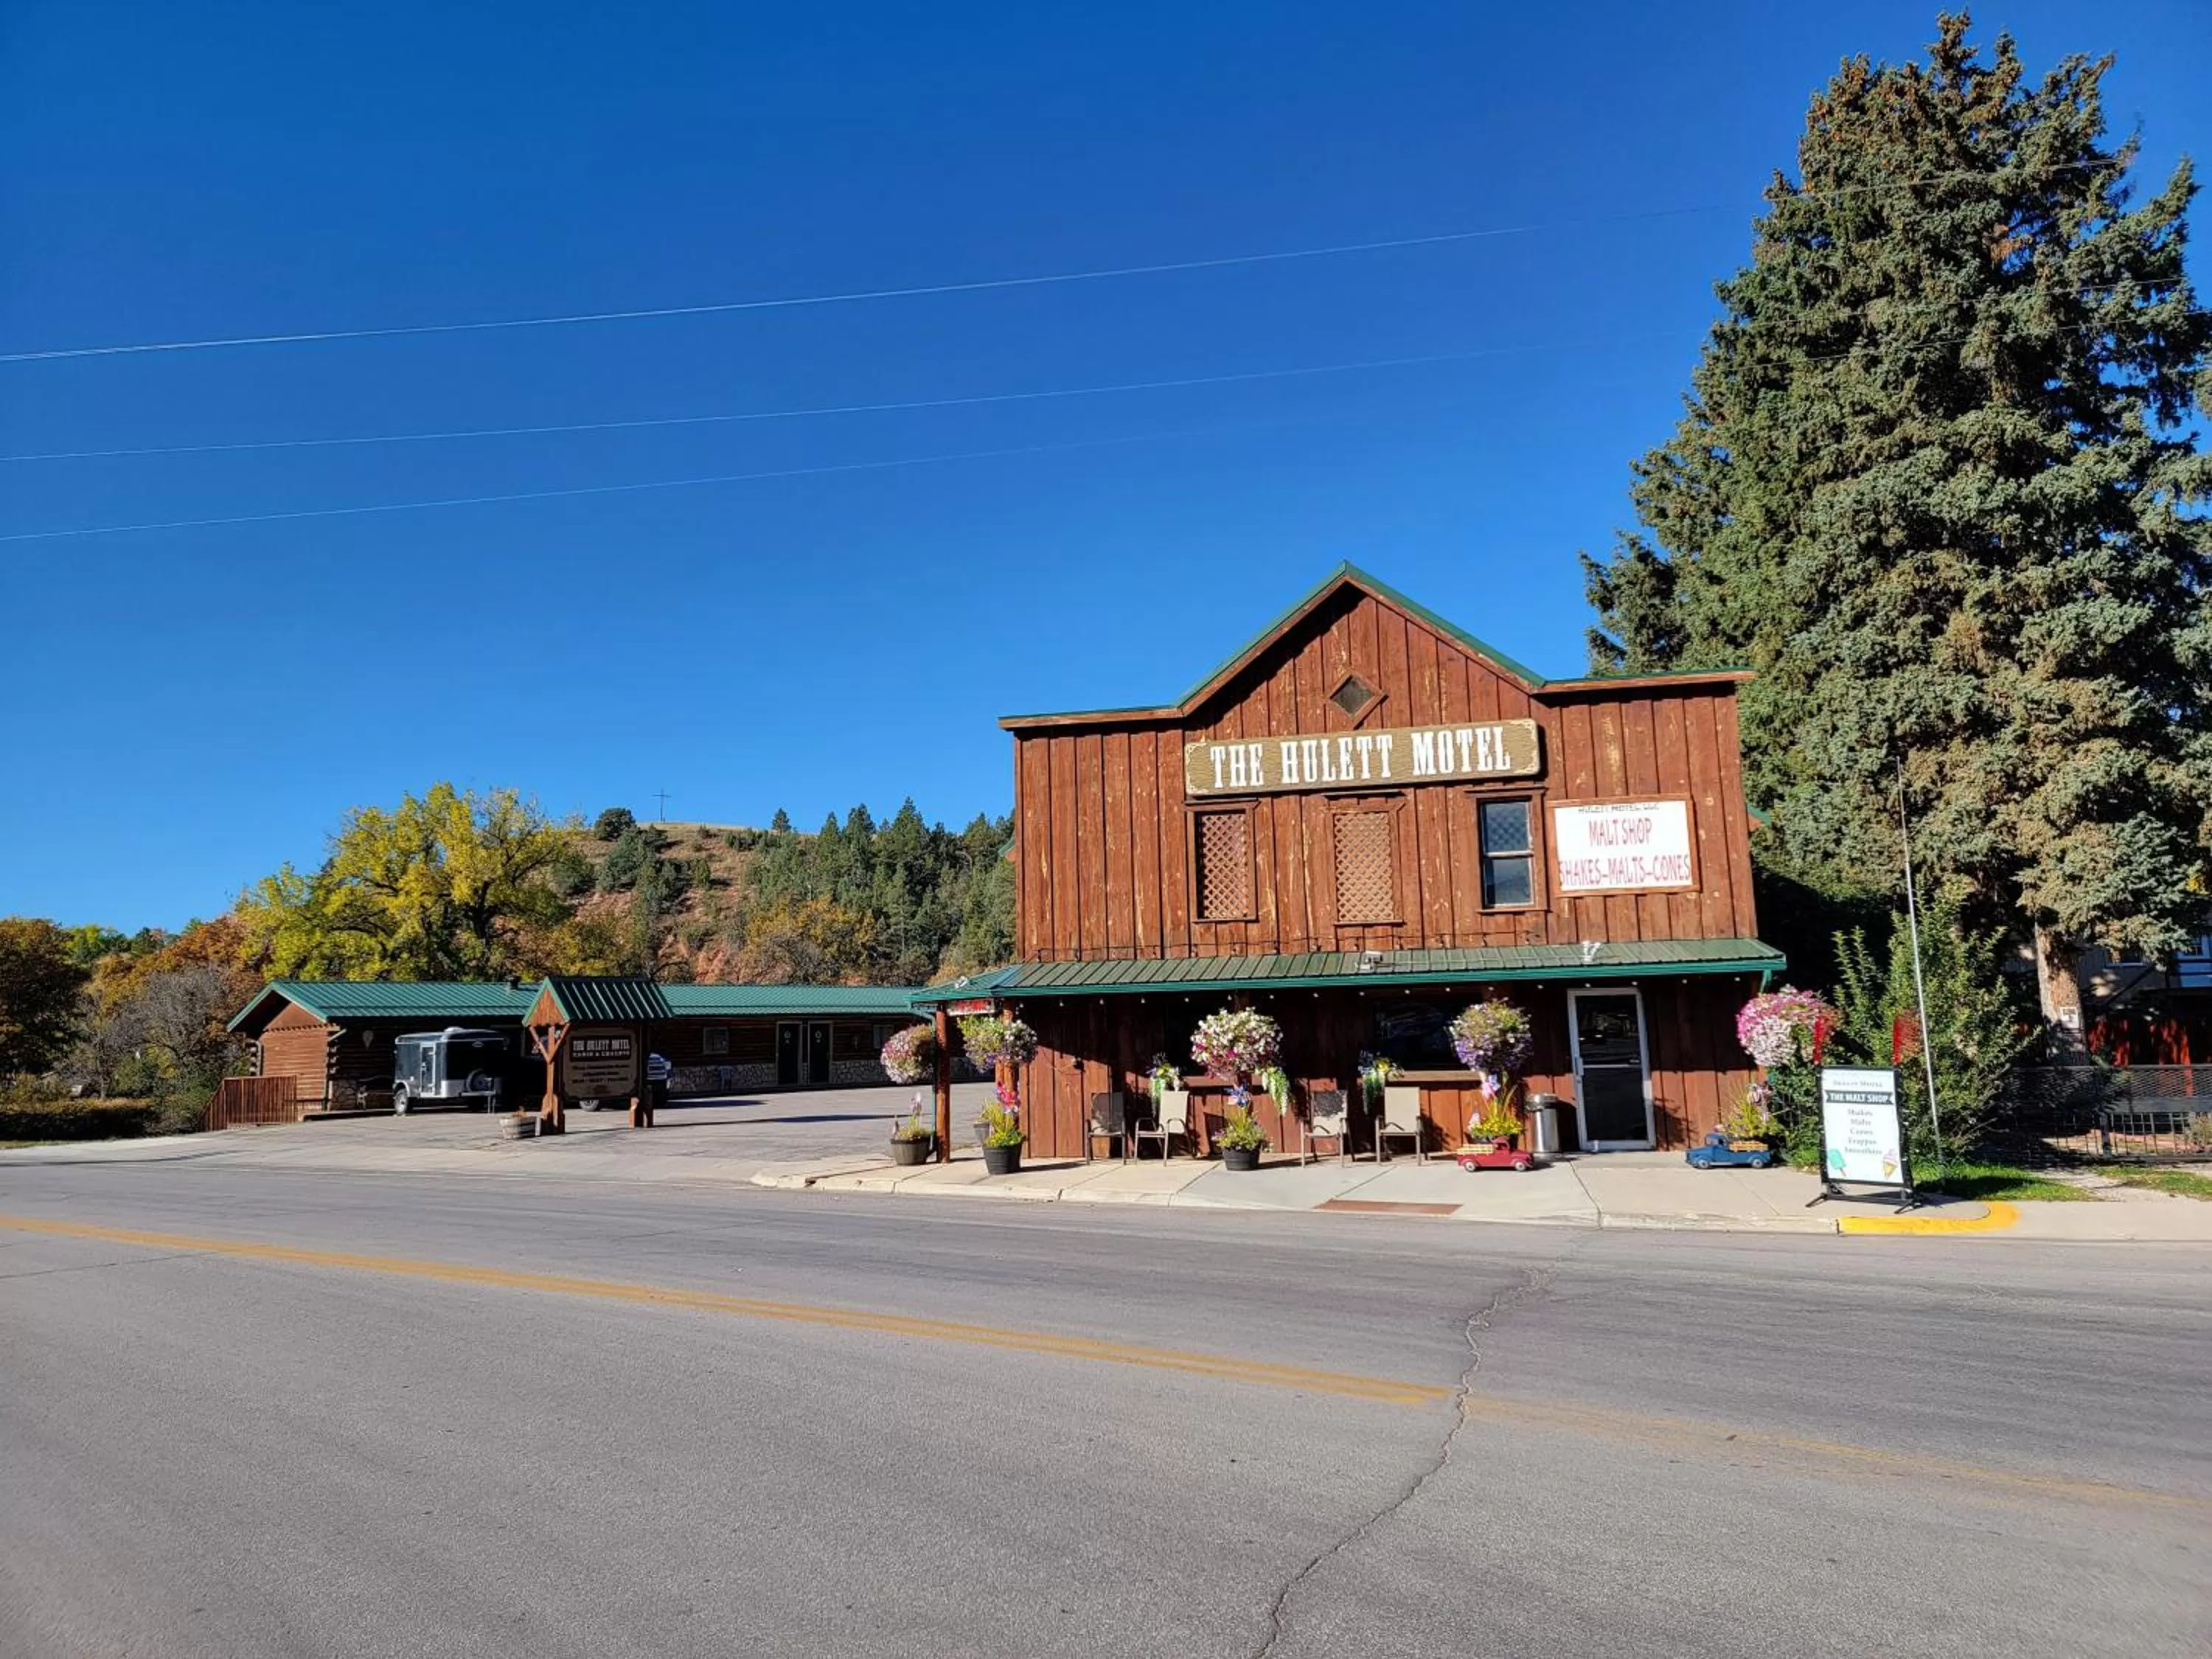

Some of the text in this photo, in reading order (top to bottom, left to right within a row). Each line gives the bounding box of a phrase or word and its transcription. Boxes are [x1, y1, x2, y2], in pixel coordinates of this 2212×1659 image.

[1210, 726, 1512, 788] THE HULETT MOTEL
[1588, 817, 1652, 846] MALT SHOP
[1846, 1093, 1865, 1102] MALT
[1867, 1093, 1888, 1102] SHOP
